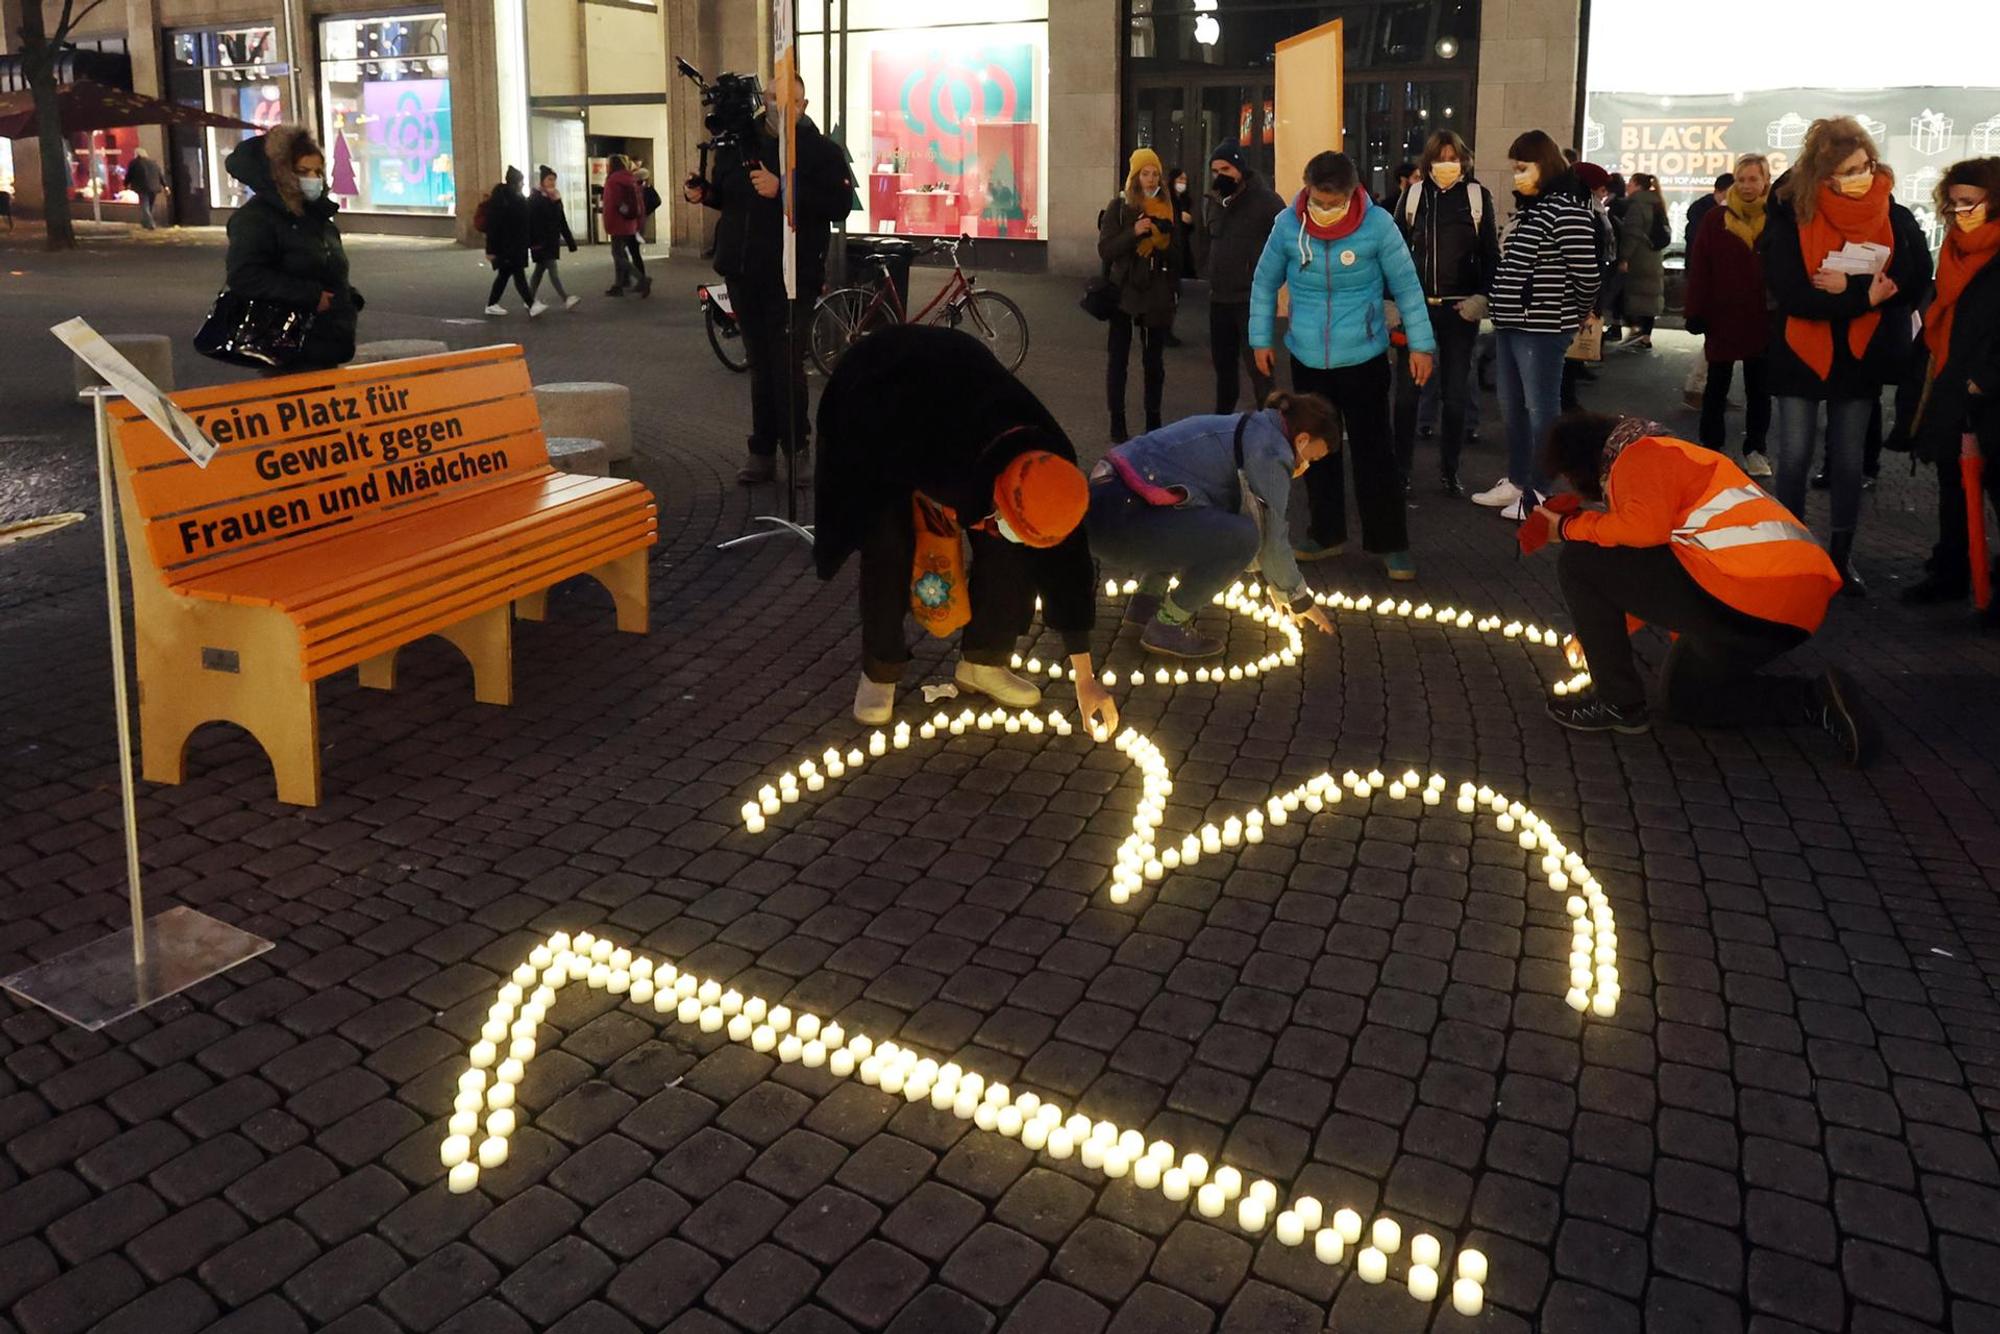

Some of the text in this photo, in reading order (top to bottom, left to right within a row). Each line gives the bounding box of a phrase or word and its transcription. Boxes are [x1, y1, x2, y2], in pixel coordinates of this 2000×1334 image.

[1620, 151, 1789, 175] SHOPPIG
[1621, 125, 1728, 151] BLACK
[195, 385, 410, 445] ein Platz für
[255, 416, 463, 481] Gewalt gegen
[179, 449, 508, 554] Frauen und Mädchen
